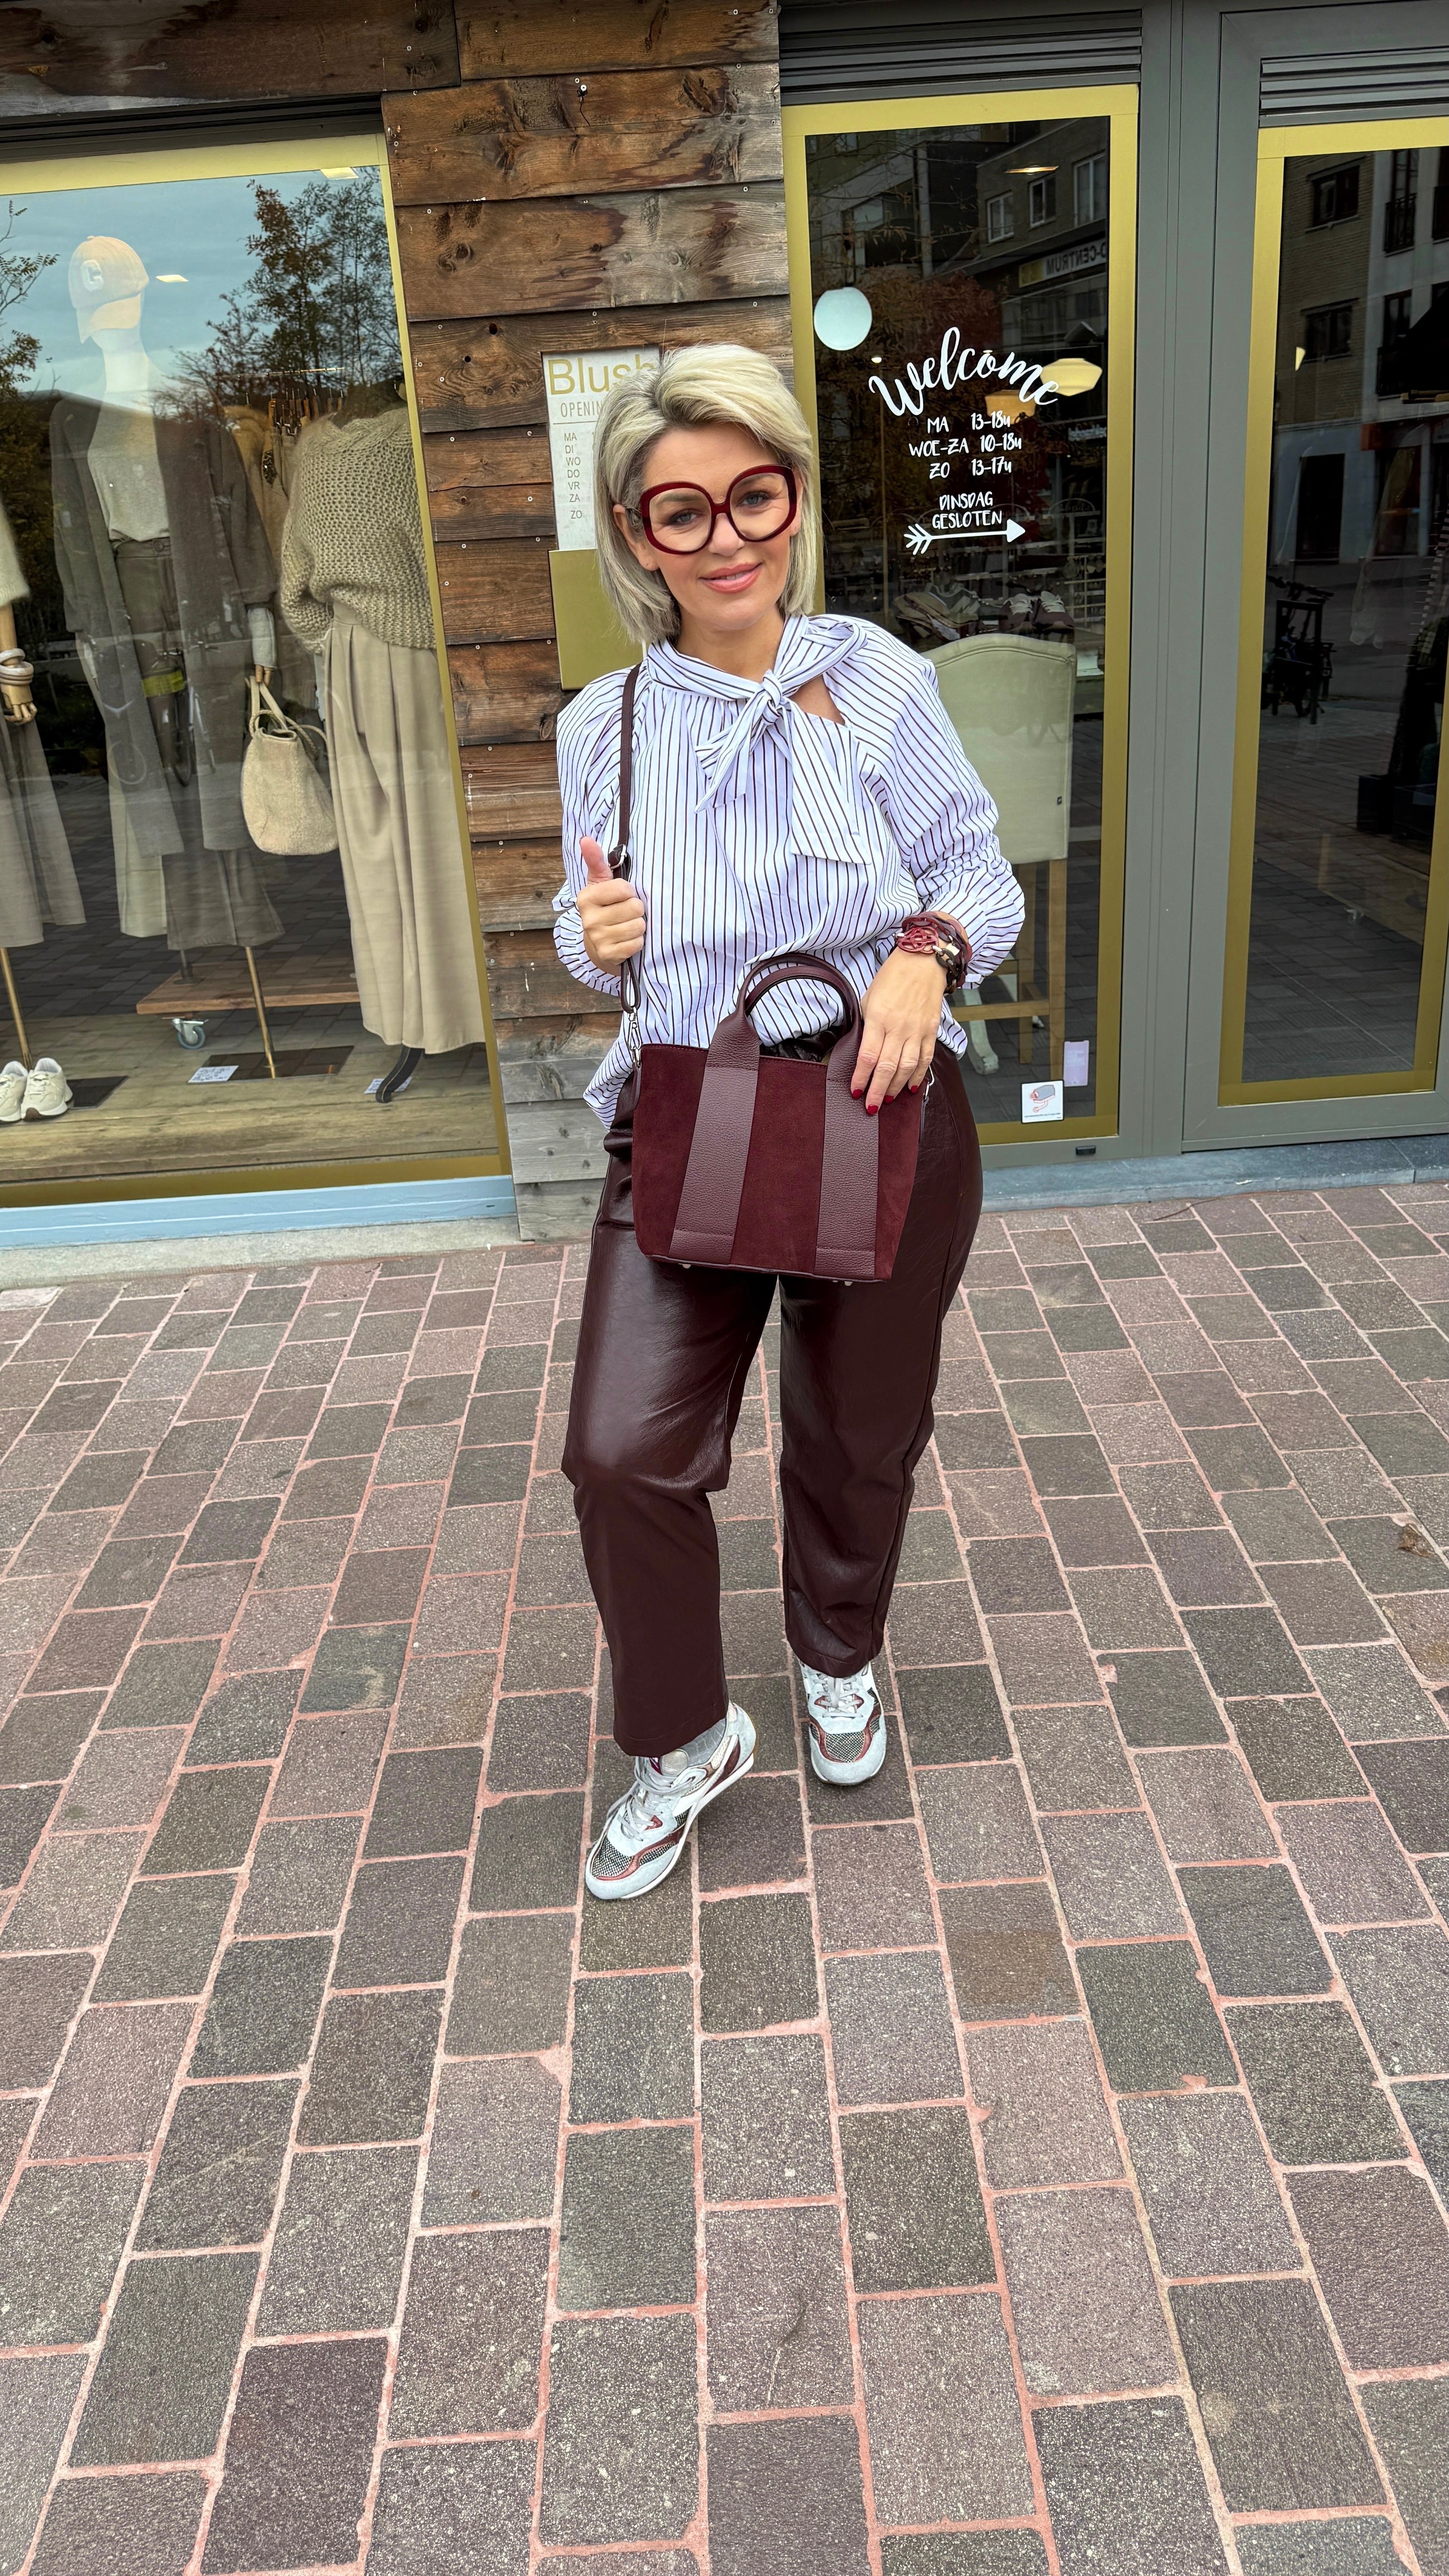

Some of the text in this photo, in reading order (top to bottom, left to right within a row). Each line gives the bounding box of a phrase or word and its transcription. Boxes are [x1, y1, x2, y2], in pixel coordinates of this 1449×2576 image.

[868, 327, 1059, 416] Welcome
[927, 410, 1011, 434] MA 13-18u
[564, 432, 577, 442] MA
[565, 445, 574, 454] DI
[908, 432, 1022, 457] WOE-ZA 10-18u
[566, 456, 581, 466] WO
[929, 456, 1012, 479] ZO 13-17u
[567, 469, 580, 478] DO
[568, 481, 580, 490] VR
[569, 494, 580, 502] ZA
[939, 491, 993, 511] DINSDAG
[570, 510, 582, 519] ZO
[932, 510, 1002, 529] GESLOTEN
